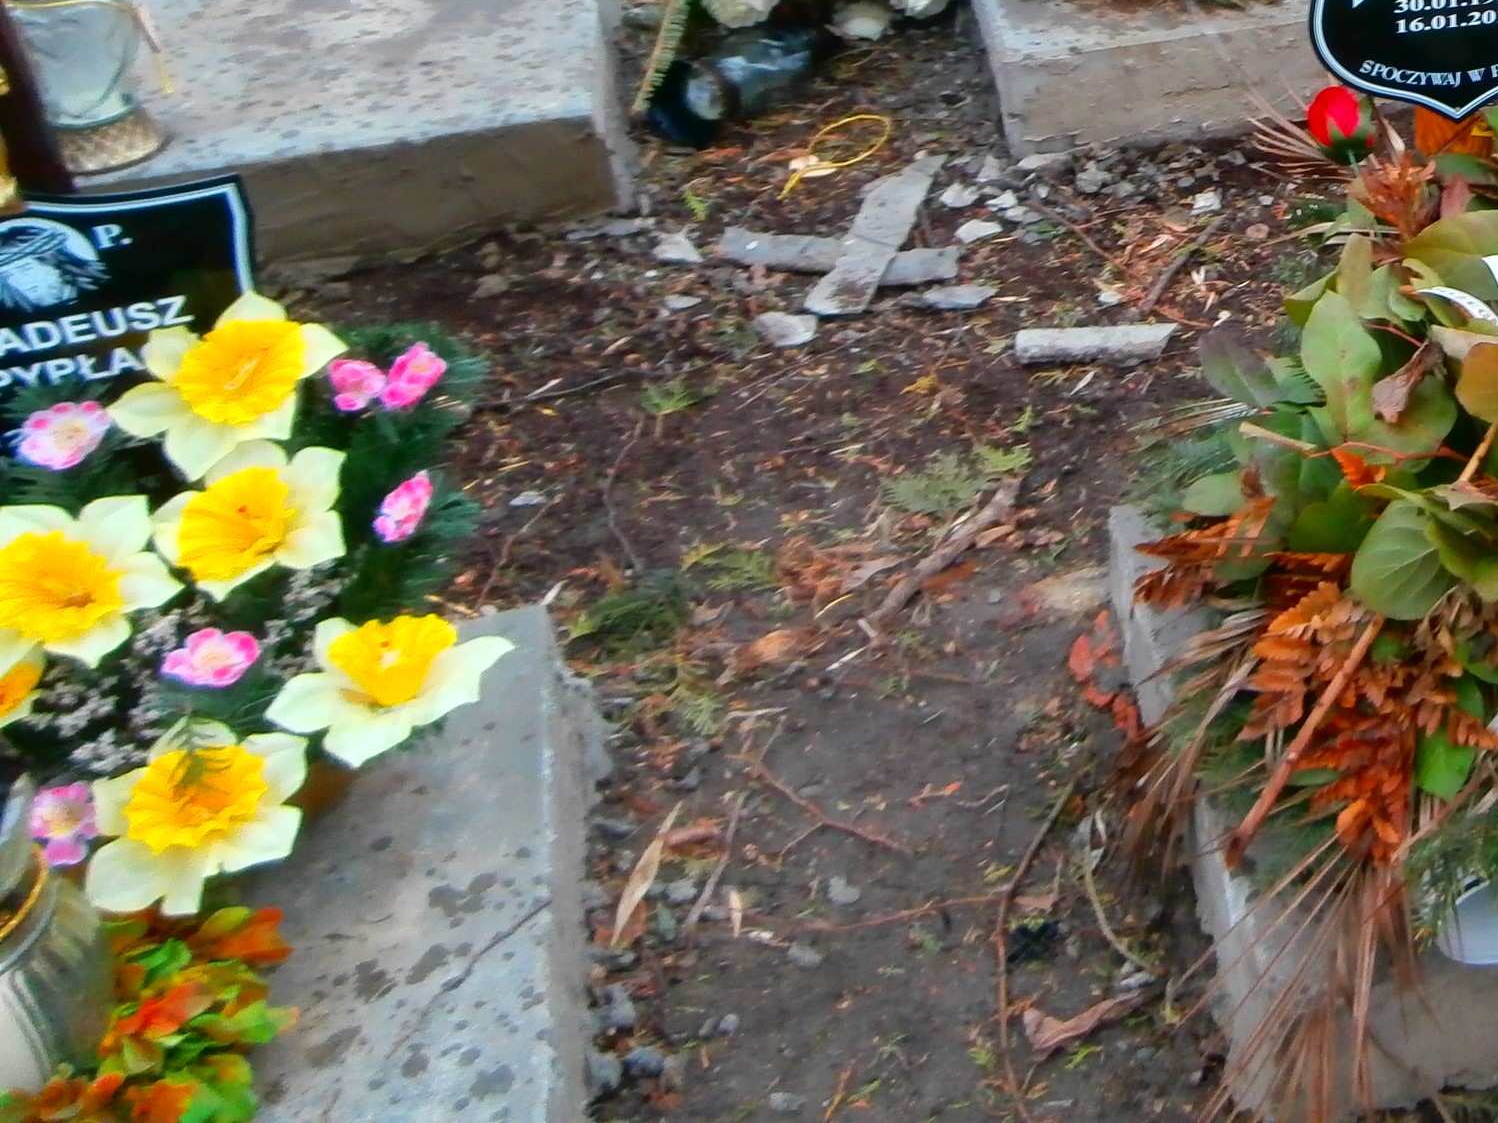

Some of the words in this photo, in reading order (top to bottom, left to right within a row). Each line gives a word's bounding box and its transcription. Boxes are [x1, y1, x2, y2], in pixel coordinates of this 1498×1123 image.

[1358, 60, 1462, 89] SPOCZYWAJ
[1467, 68, 1486, 83] W
[92, 224, 134, 249] P.
